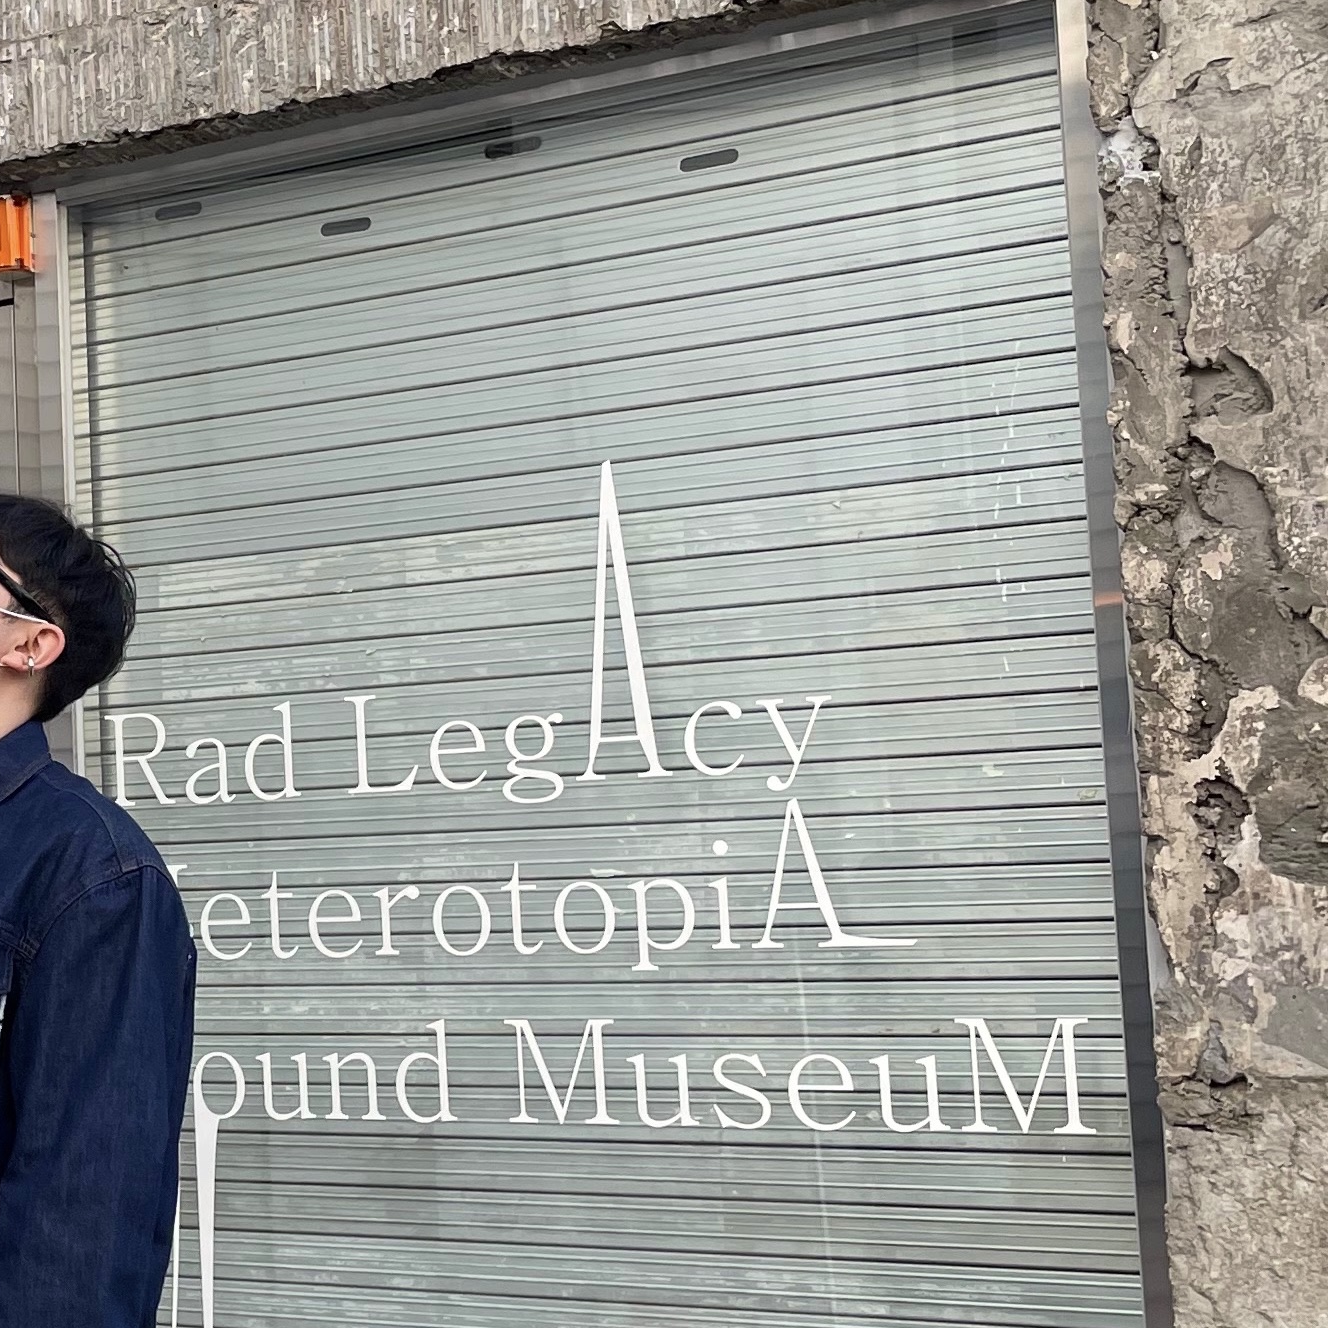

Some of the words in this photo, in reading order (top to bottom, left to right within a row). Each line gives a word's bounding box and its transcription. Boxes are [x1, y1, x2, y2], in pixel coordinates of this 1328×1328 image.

[104, 700, 302, 807] Rad
[343, 460, 832, 804] LegAcy
[503, 1017, 1097, 1134] MuseuM
